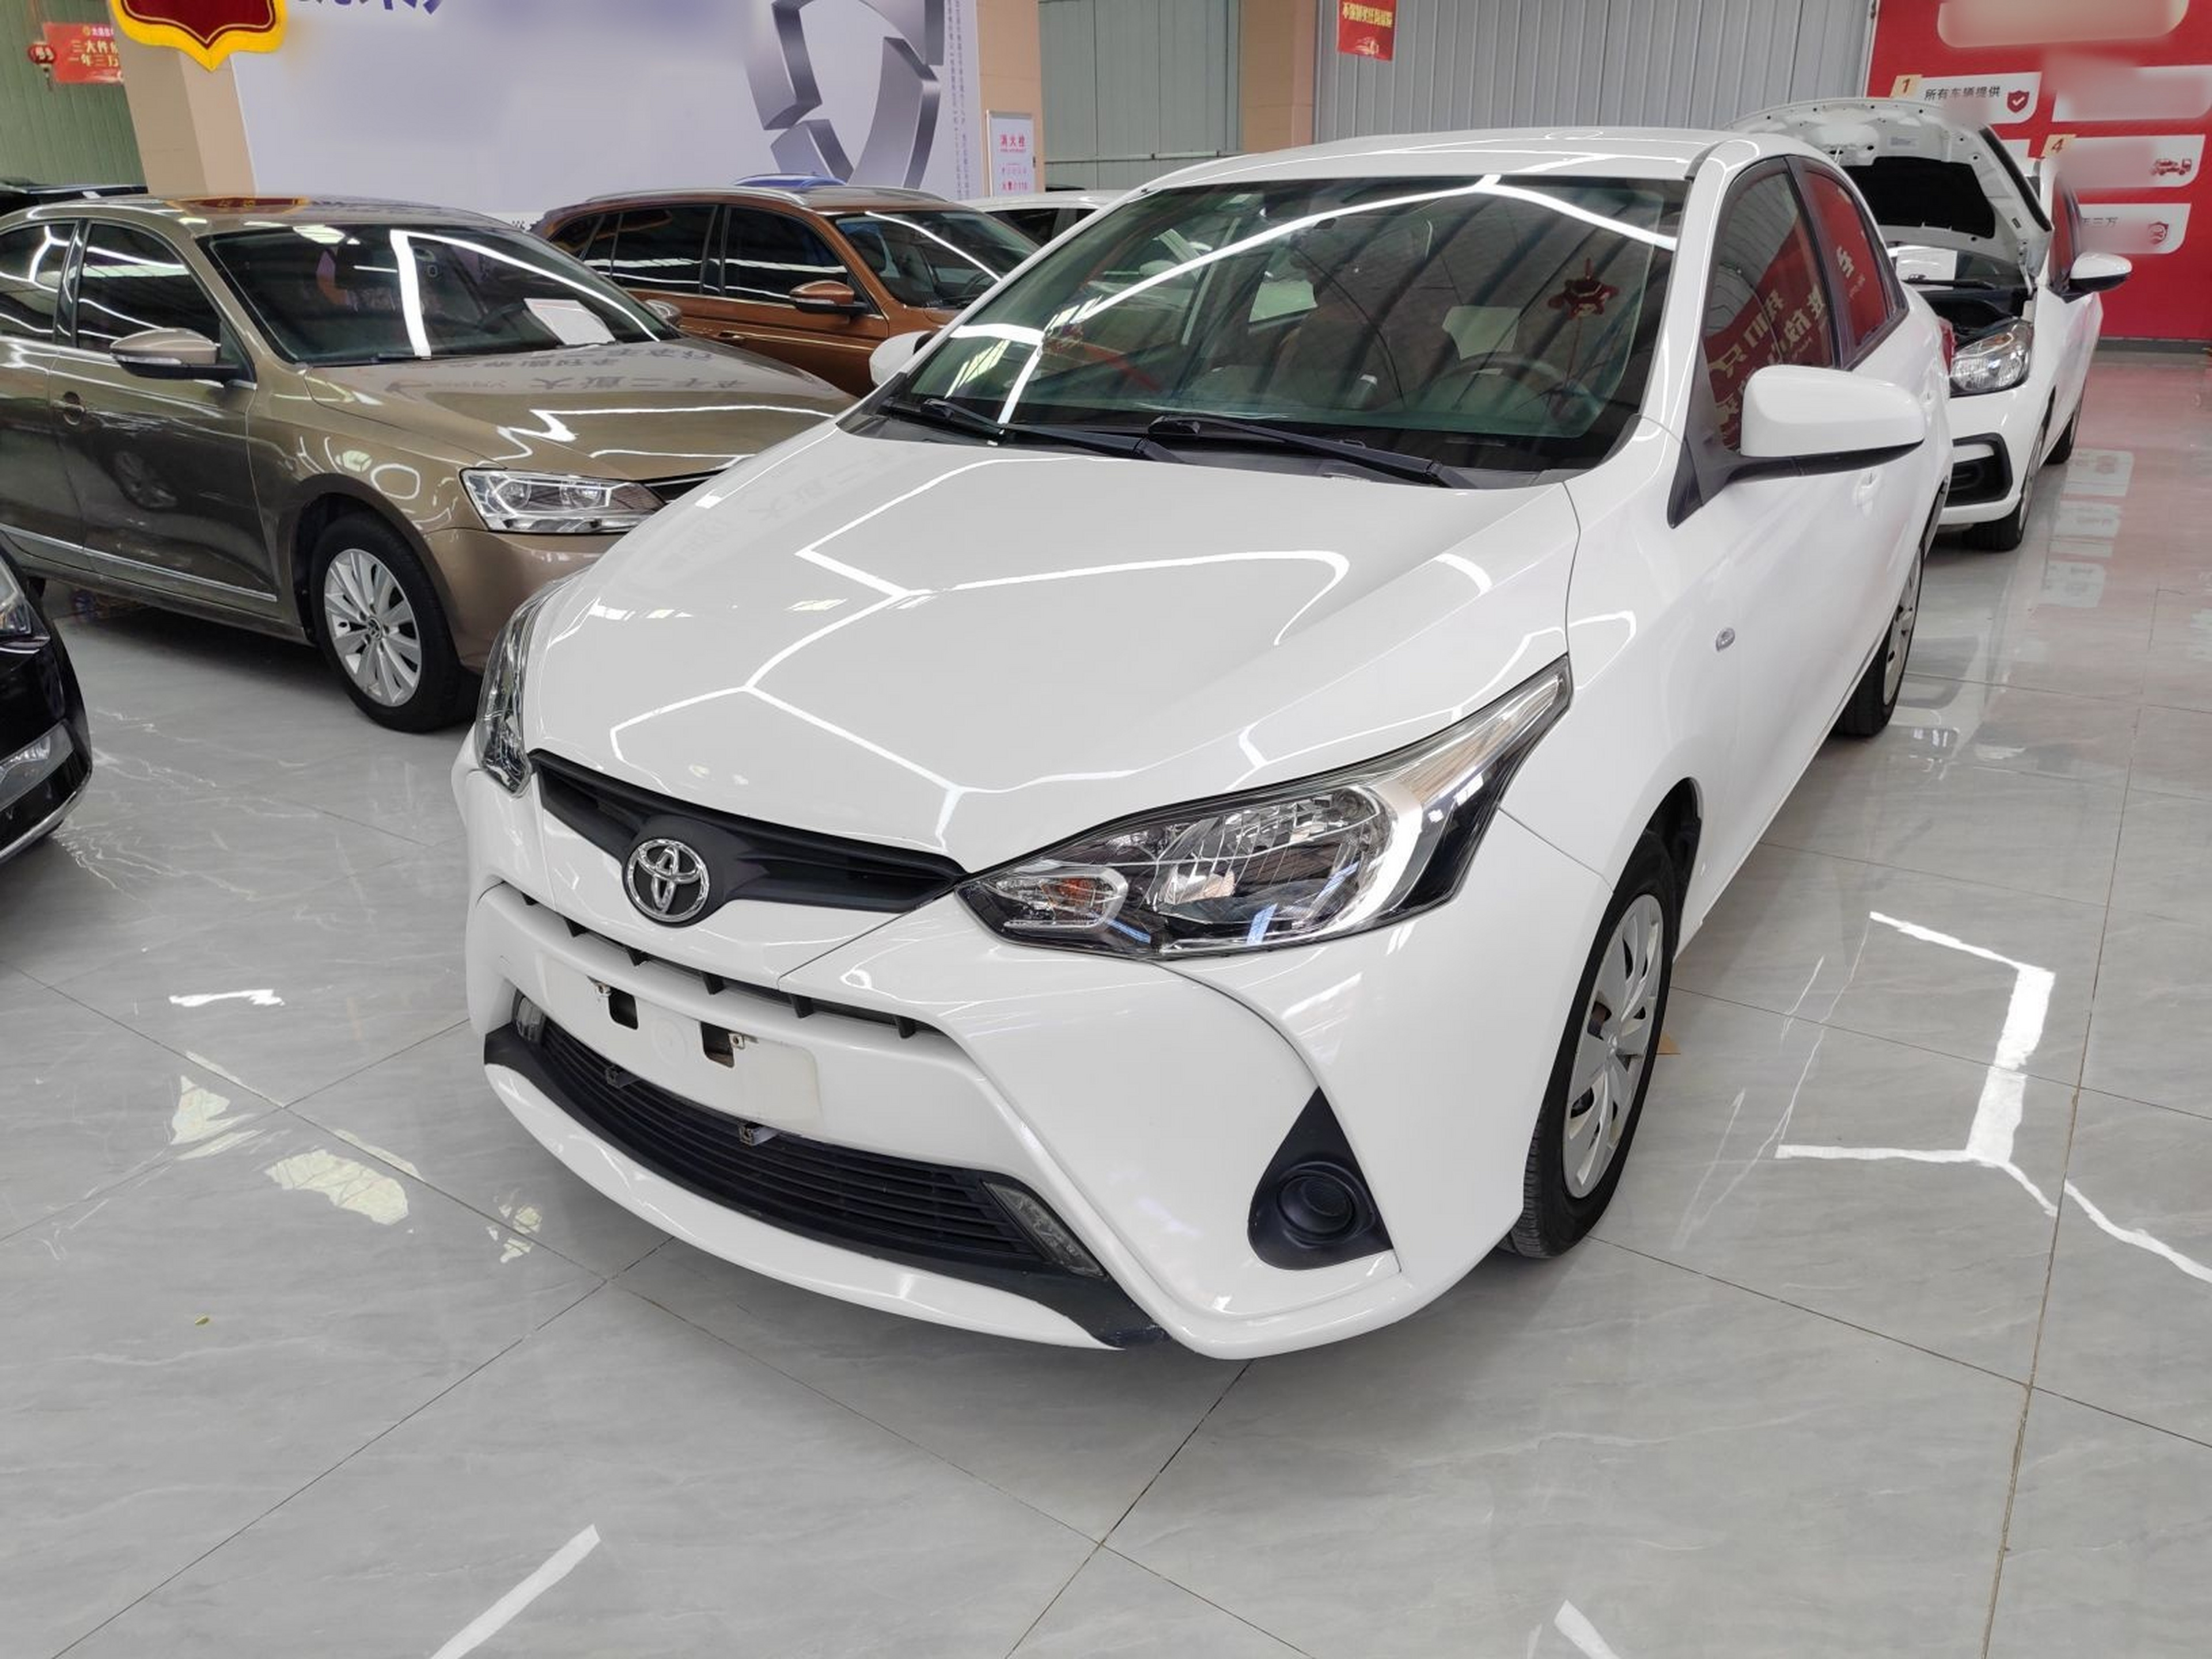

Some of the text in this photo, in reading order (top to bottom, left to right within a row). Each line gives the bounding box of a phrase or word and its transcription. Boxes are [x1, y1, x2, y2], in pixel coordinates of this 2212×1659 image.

[1903, 78, 1910, 93] 1
[1924, 86, 2001, 100] 所有车辆提供
[2051, 138, 2064, 152] 4
